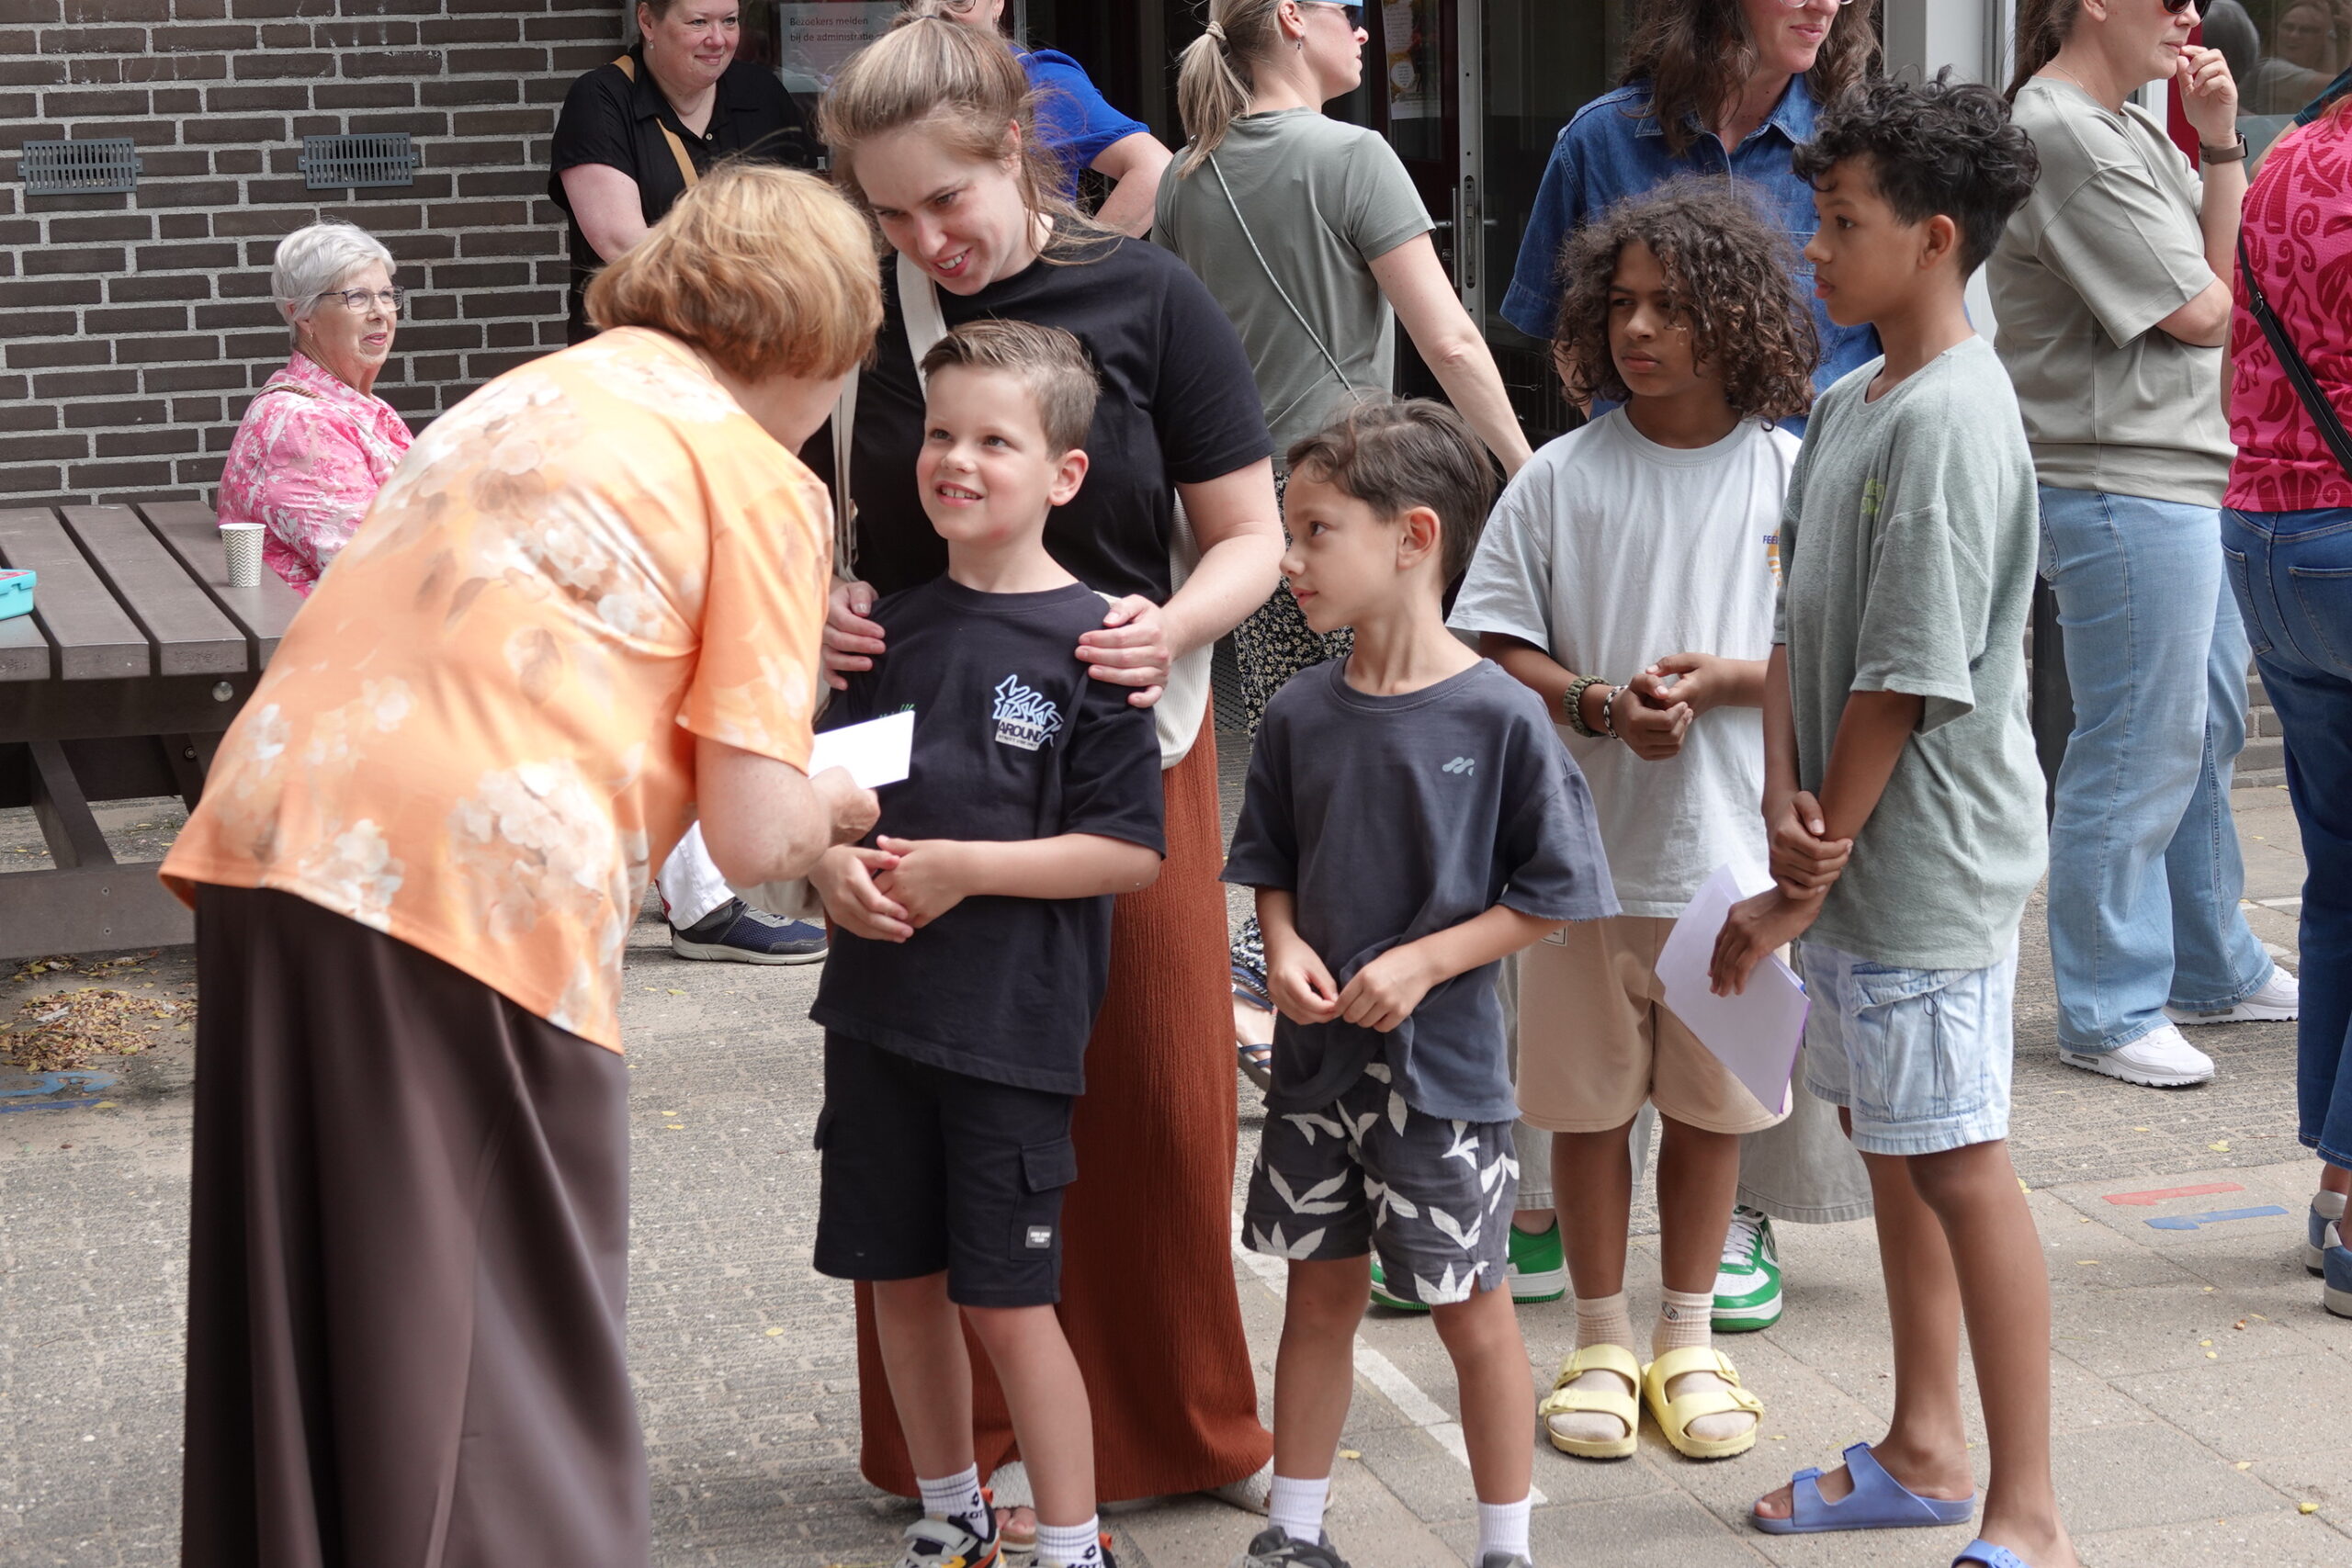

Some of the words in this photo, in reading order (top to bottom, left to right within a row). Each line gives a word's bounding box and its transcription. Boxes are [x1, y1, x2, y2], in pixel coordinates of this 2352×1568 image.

[789, 17, 833, 26] Bezoekers
[836, 17, 868, 26] melden
[790, 33, 801, 43] bij
[803, 33, 815, 41] de
[817, 33, 874, 42] administratie
[999, 721, 1043, 743] AROUND
